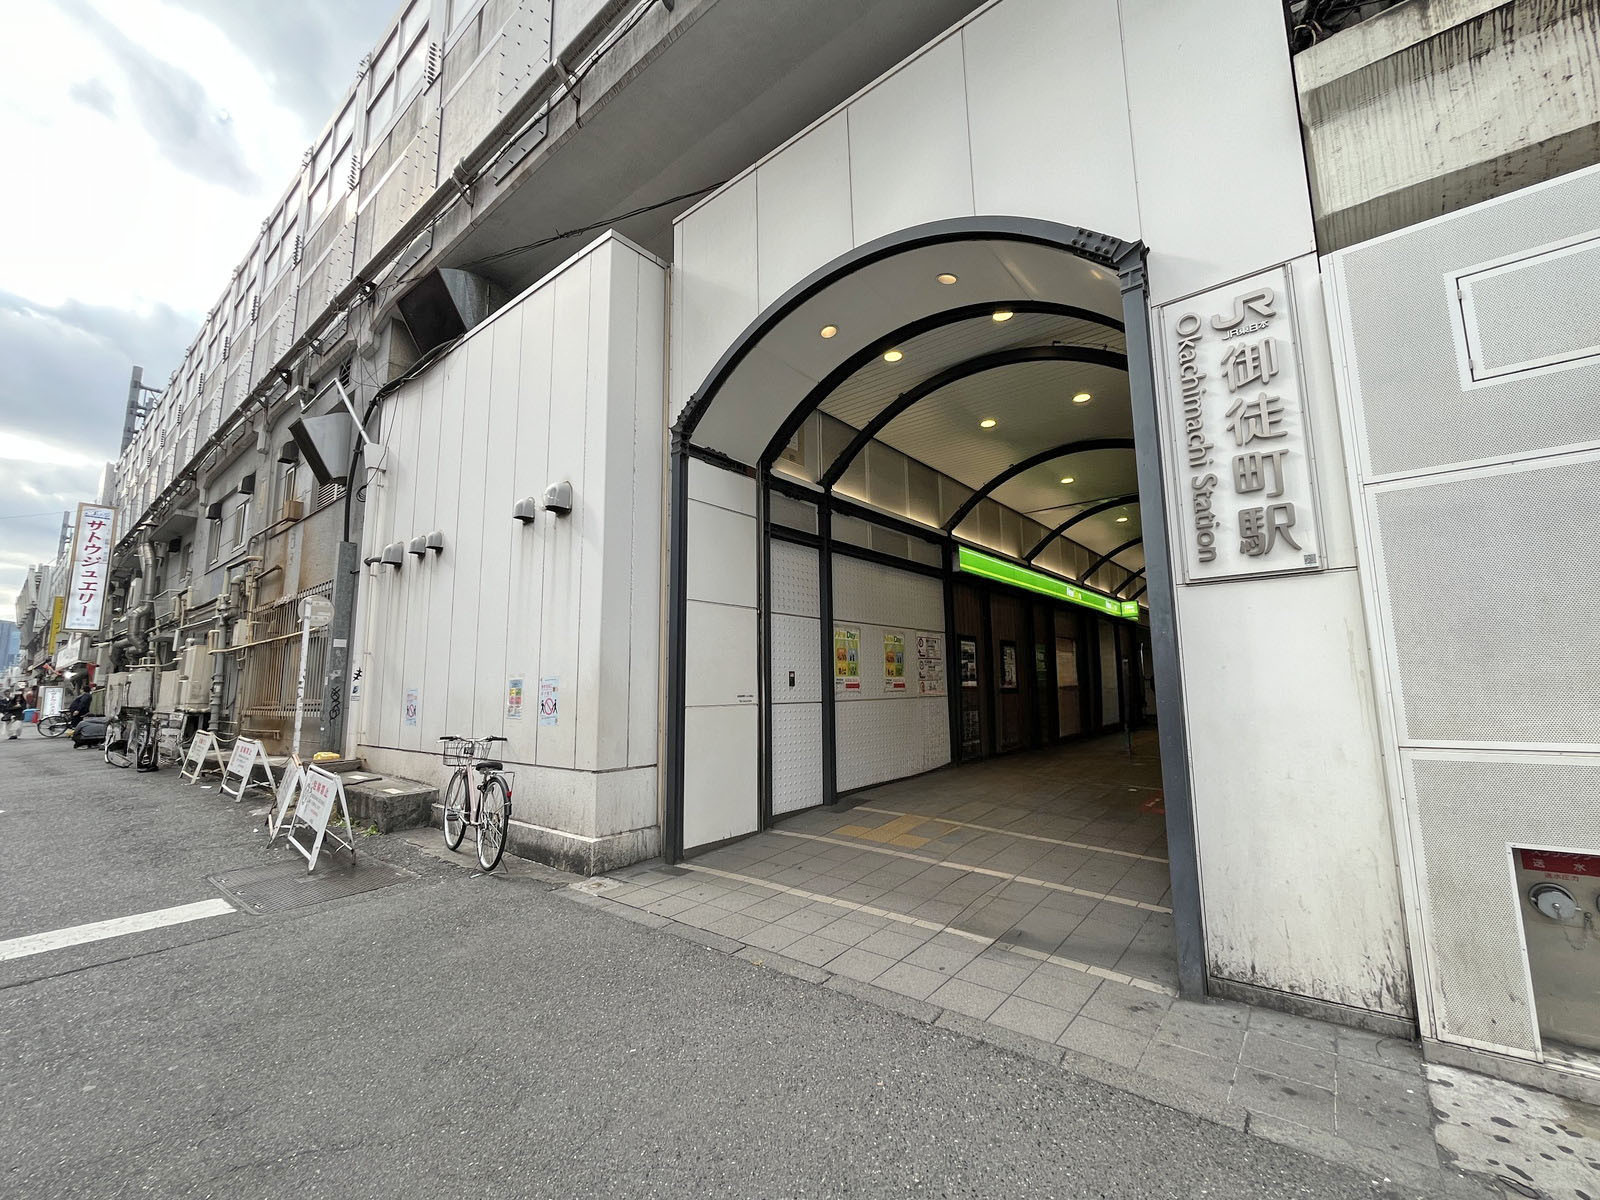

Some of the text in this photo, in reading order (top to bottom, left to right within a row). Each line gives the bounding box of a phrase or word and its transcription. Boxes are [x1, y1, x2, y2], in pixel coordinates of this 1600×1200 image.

[1211, 287, 1277, 330] JR
[1176, 312, 1222, 563] Okachimachi Station
[1221, 337, 1302, 557] 御徒町駅
[78, 520, 107, 617] サトウジュエリー
